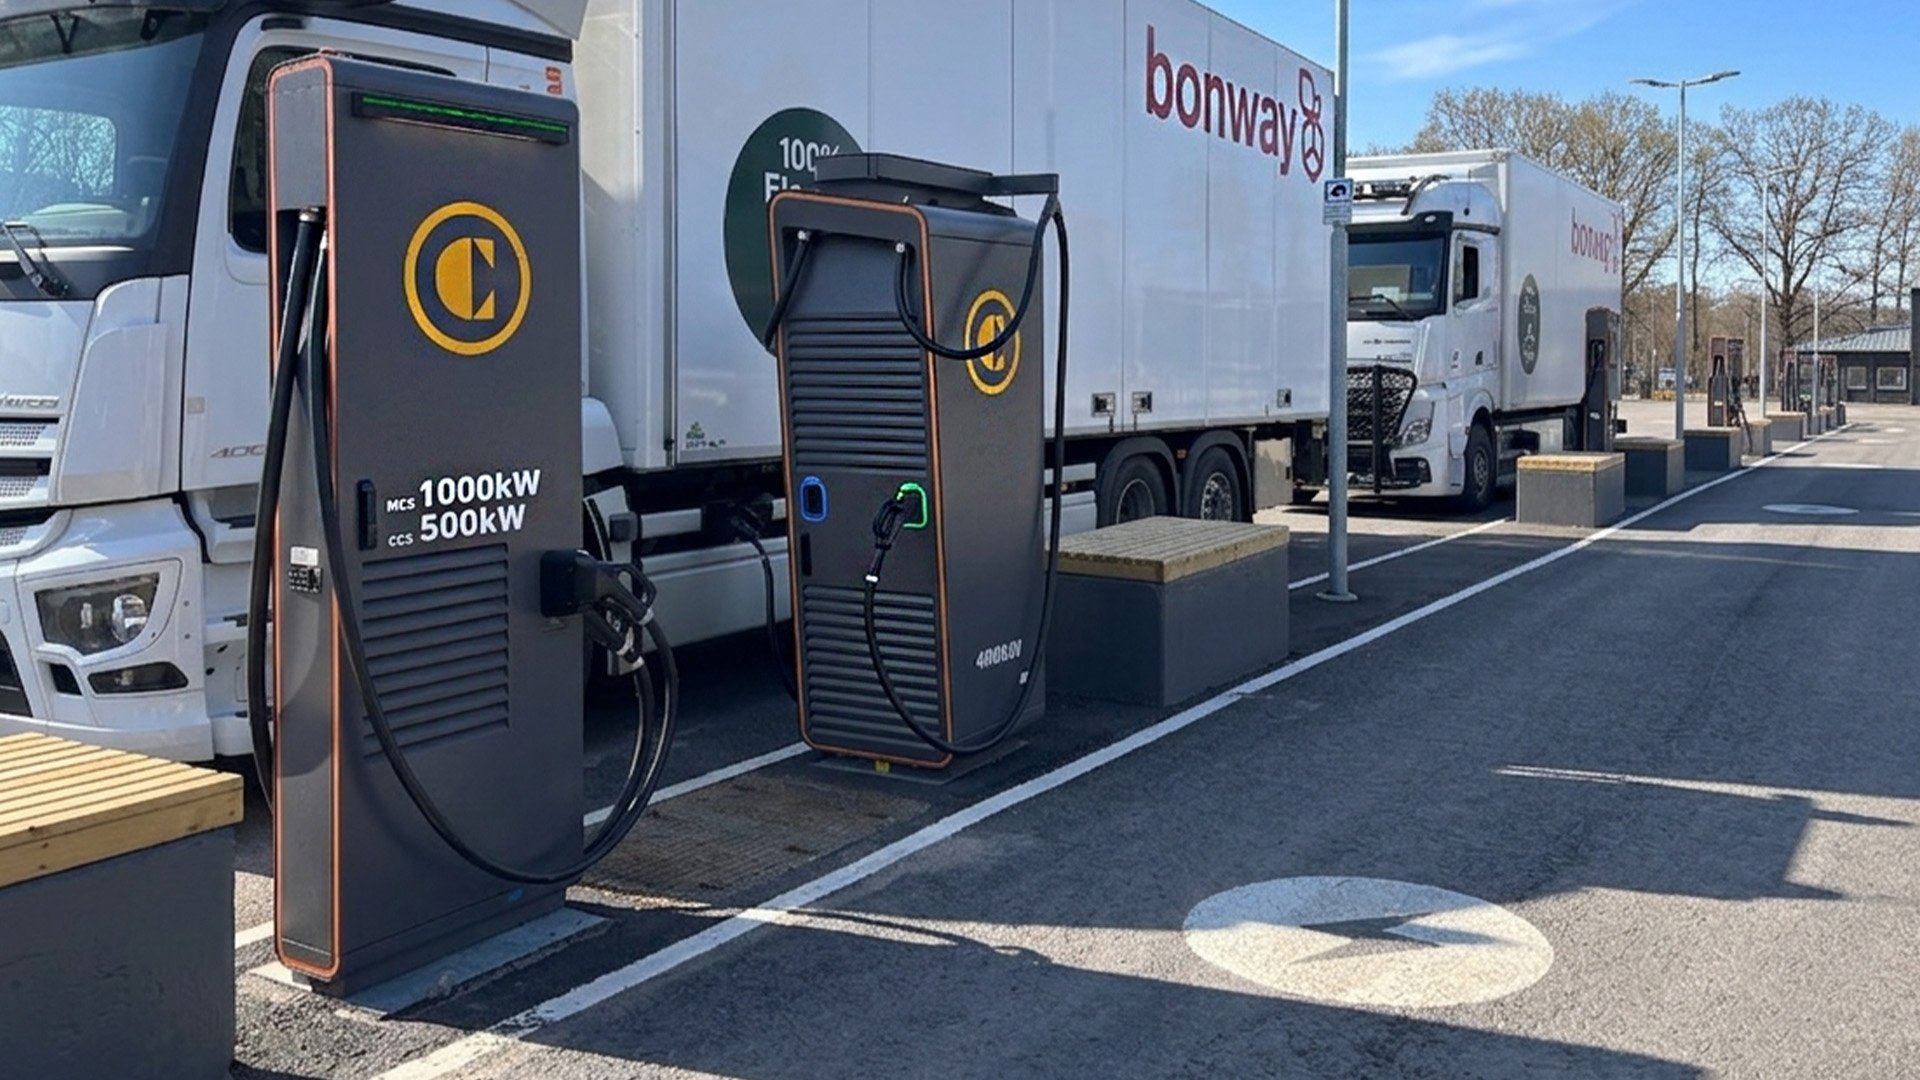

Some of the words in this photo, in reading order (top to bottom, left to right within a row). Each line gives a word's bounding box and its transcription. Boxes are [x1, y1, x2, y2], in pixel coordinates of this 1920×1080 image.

[1146, 25, 1298, 175] bonway
[386, 497, 415, 512] MCS
[419, 469, 541, 508] 1000kW
[387, 533, 414, 547] CCS
[420, 504, 526, 541] 500kW
